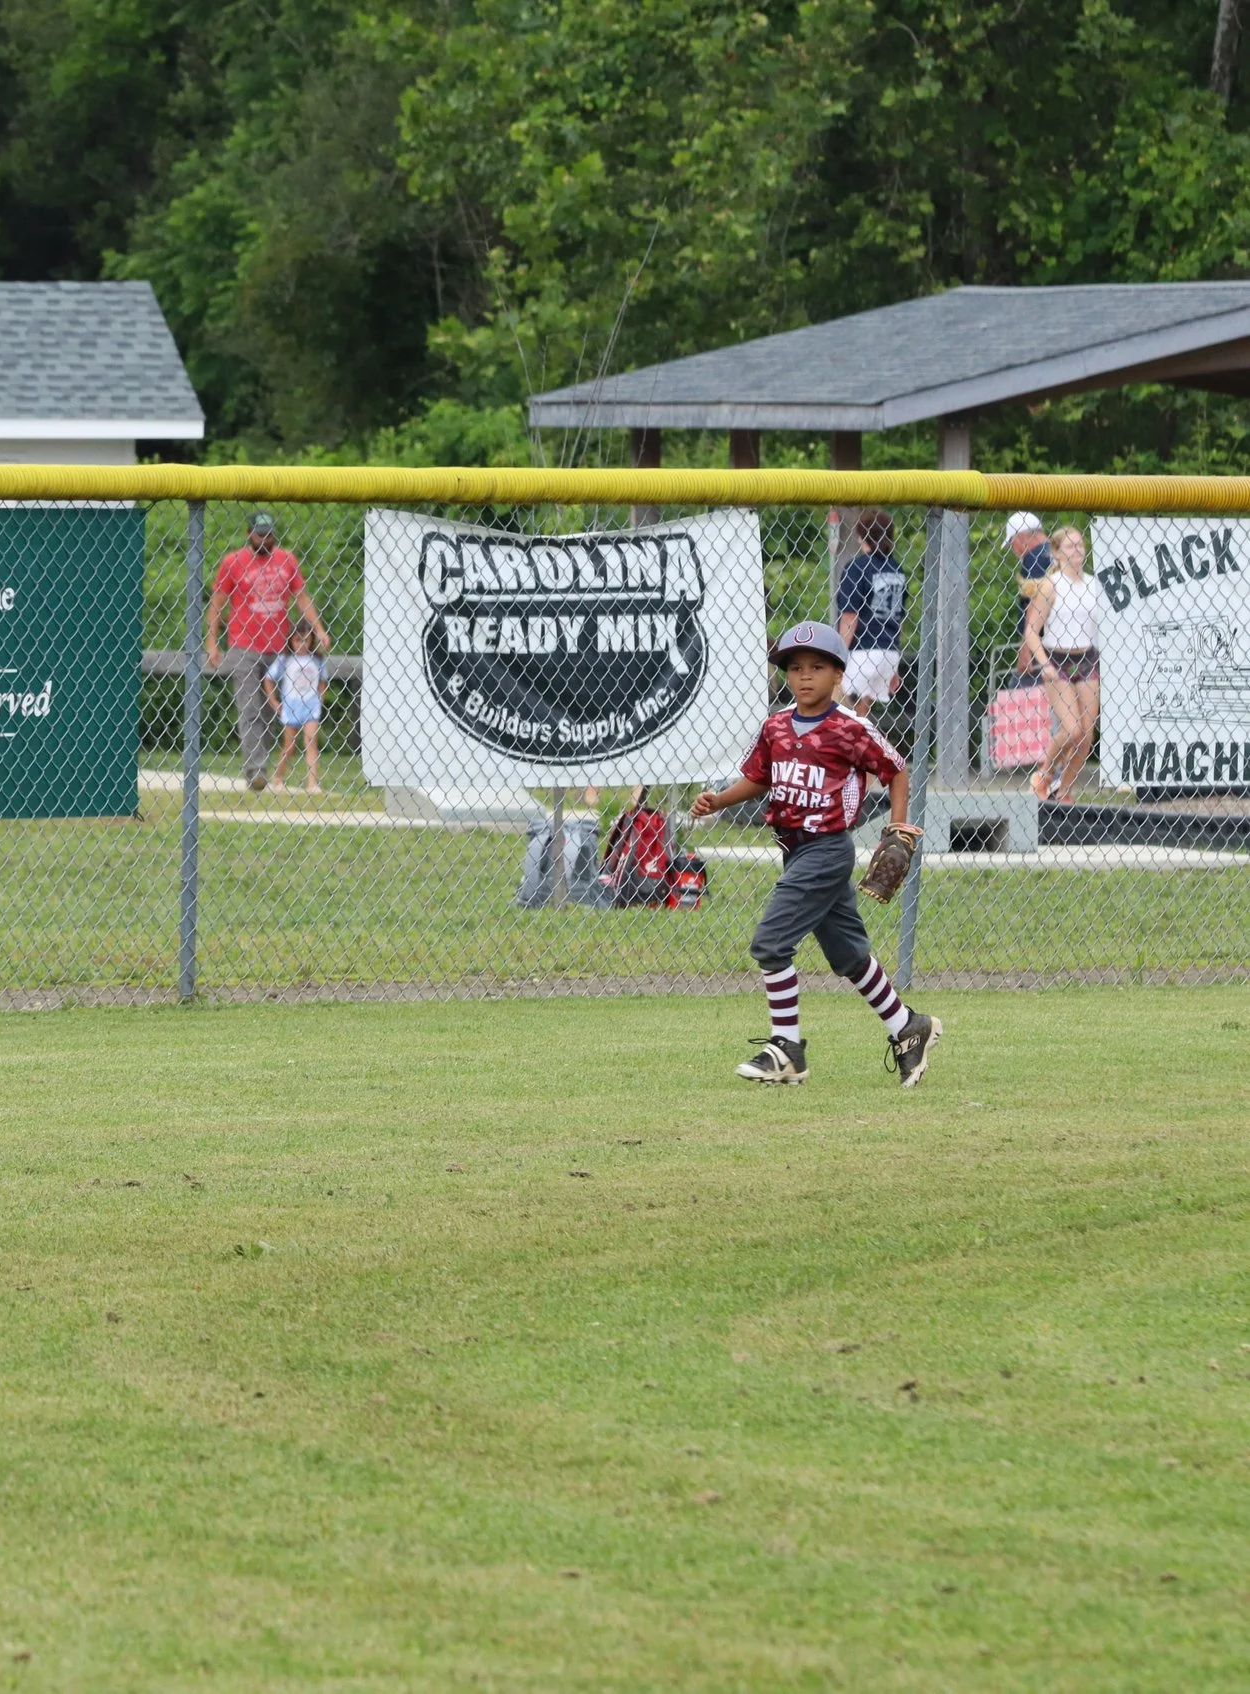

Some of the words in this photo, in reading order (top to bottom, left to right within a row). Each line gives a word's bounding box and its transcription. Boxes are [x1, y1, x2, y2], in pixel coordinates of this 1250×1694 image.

[422, 536, 702, 605] CAROLINA
[1097, 527, 1241, 614] BLACK
[443, 614, 586, 654] READY
[596, 613, 690, 674] MIX
[446, 673, 465, 698] &
[464, 689, 553, 743] Builders
[558, 711, 634, 748] Supply,
[635, 687, 677, 723] Inc.
